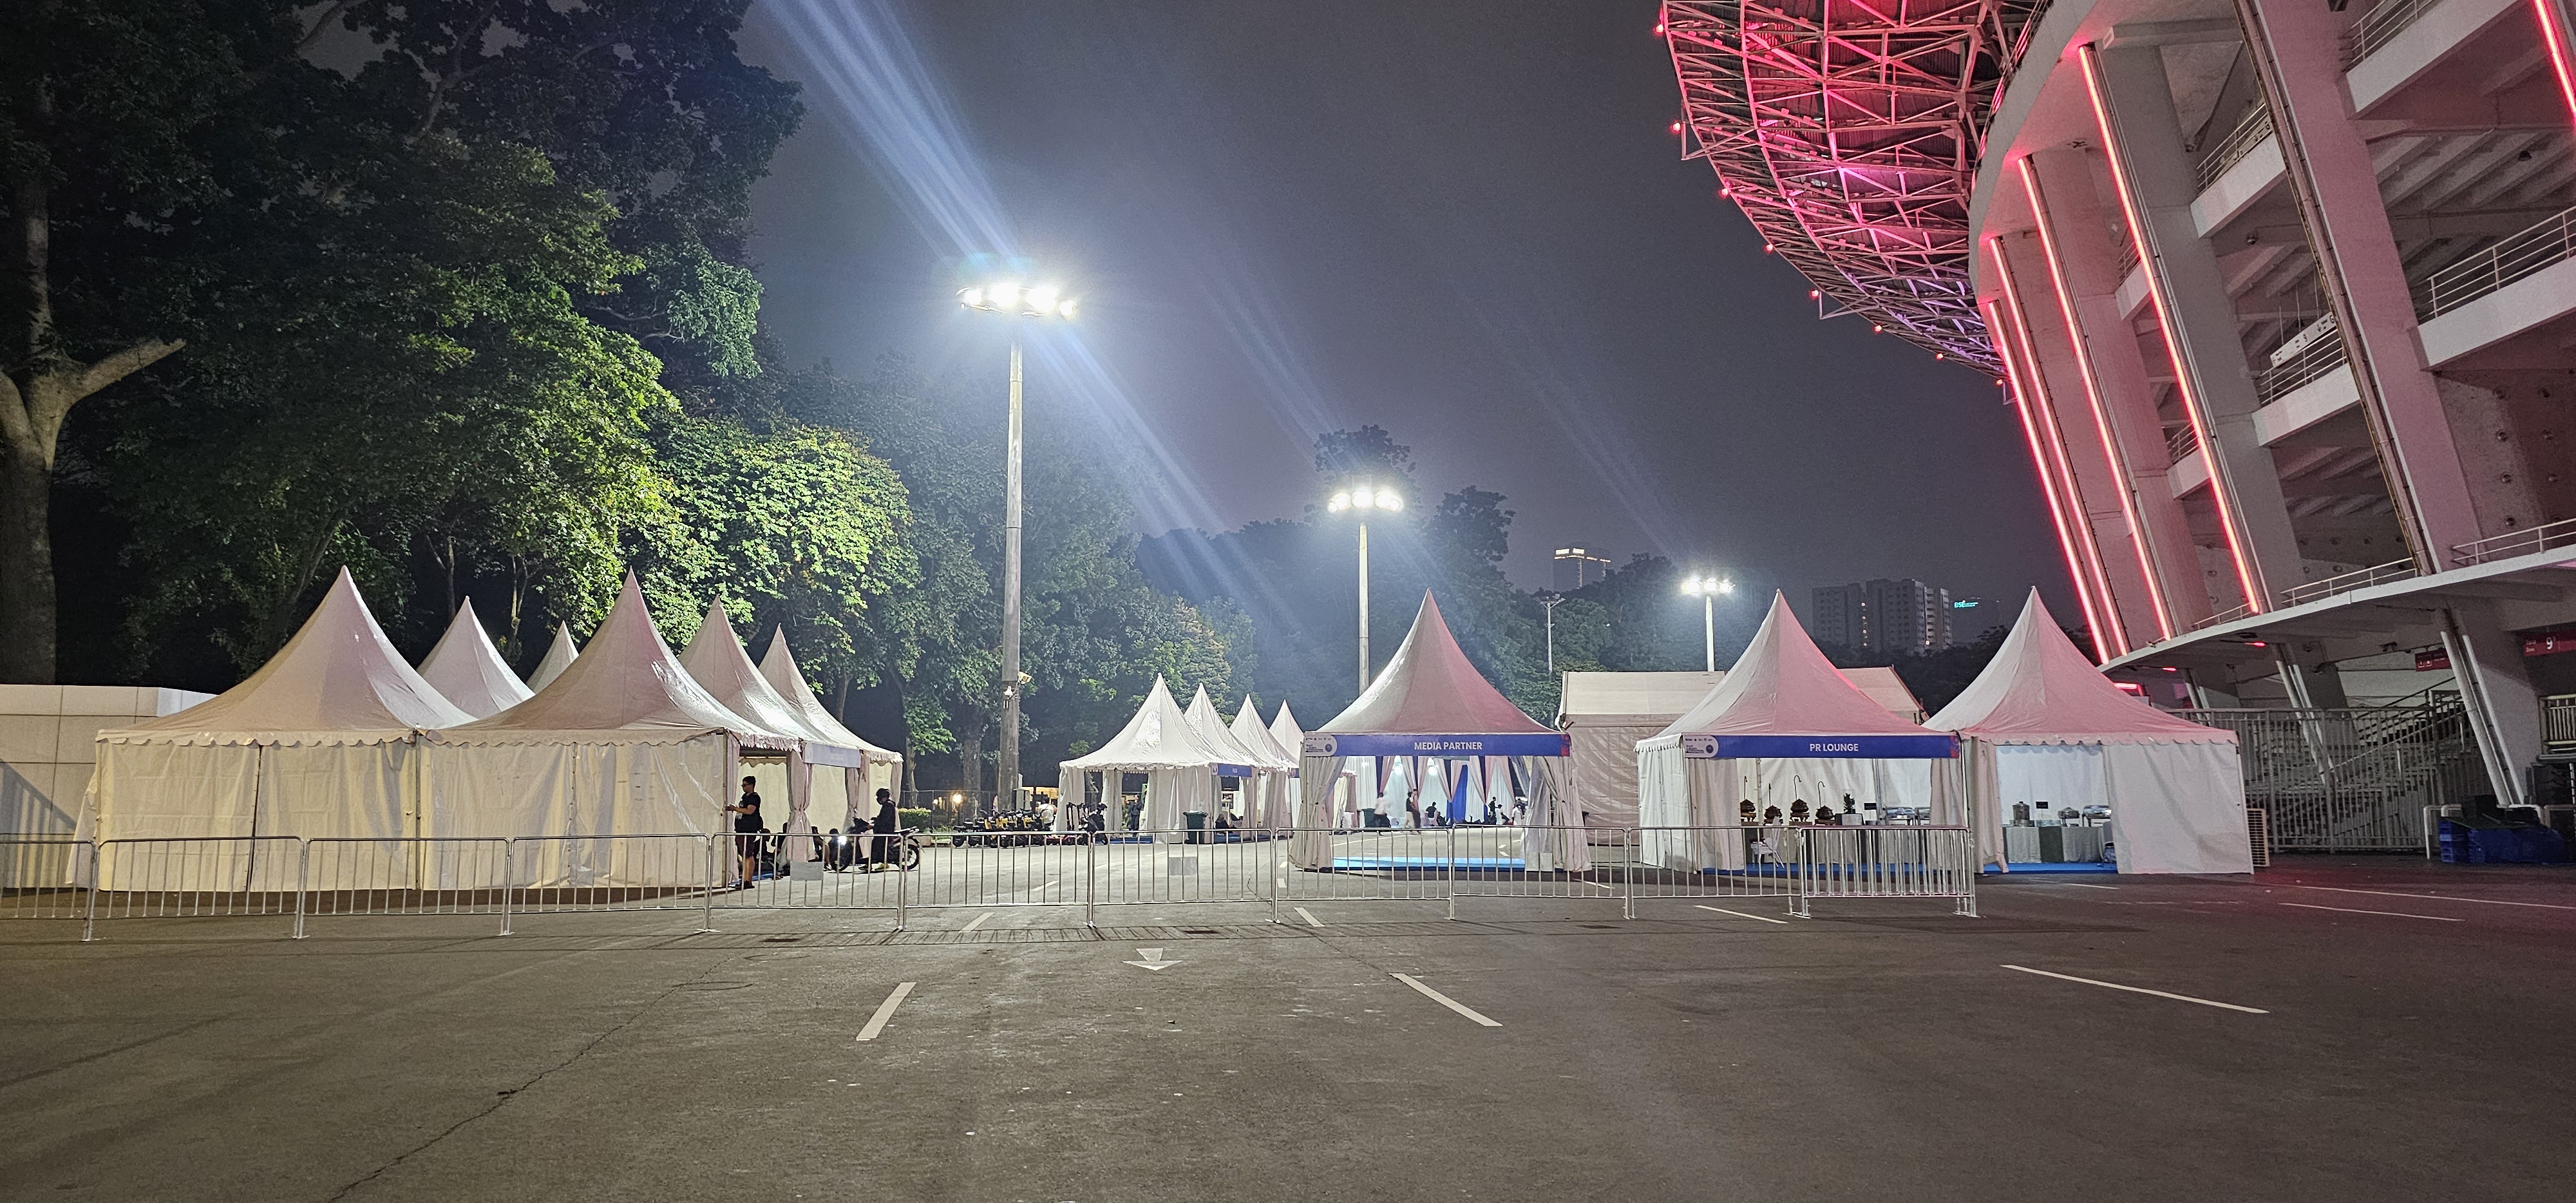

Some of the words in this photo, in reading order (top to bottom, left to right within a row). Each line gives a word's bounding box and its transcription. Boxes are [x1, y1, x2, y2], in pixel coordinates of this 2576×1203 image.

[2546, 636, 2553, 650] 9
[1414, 741, 1442, 750] MEDIA
[1443, 741, 1482, 750] PARTNER
[1809, 743, 1821, 752] PR
[1823, 743, 1859, 752] LOUNGE
